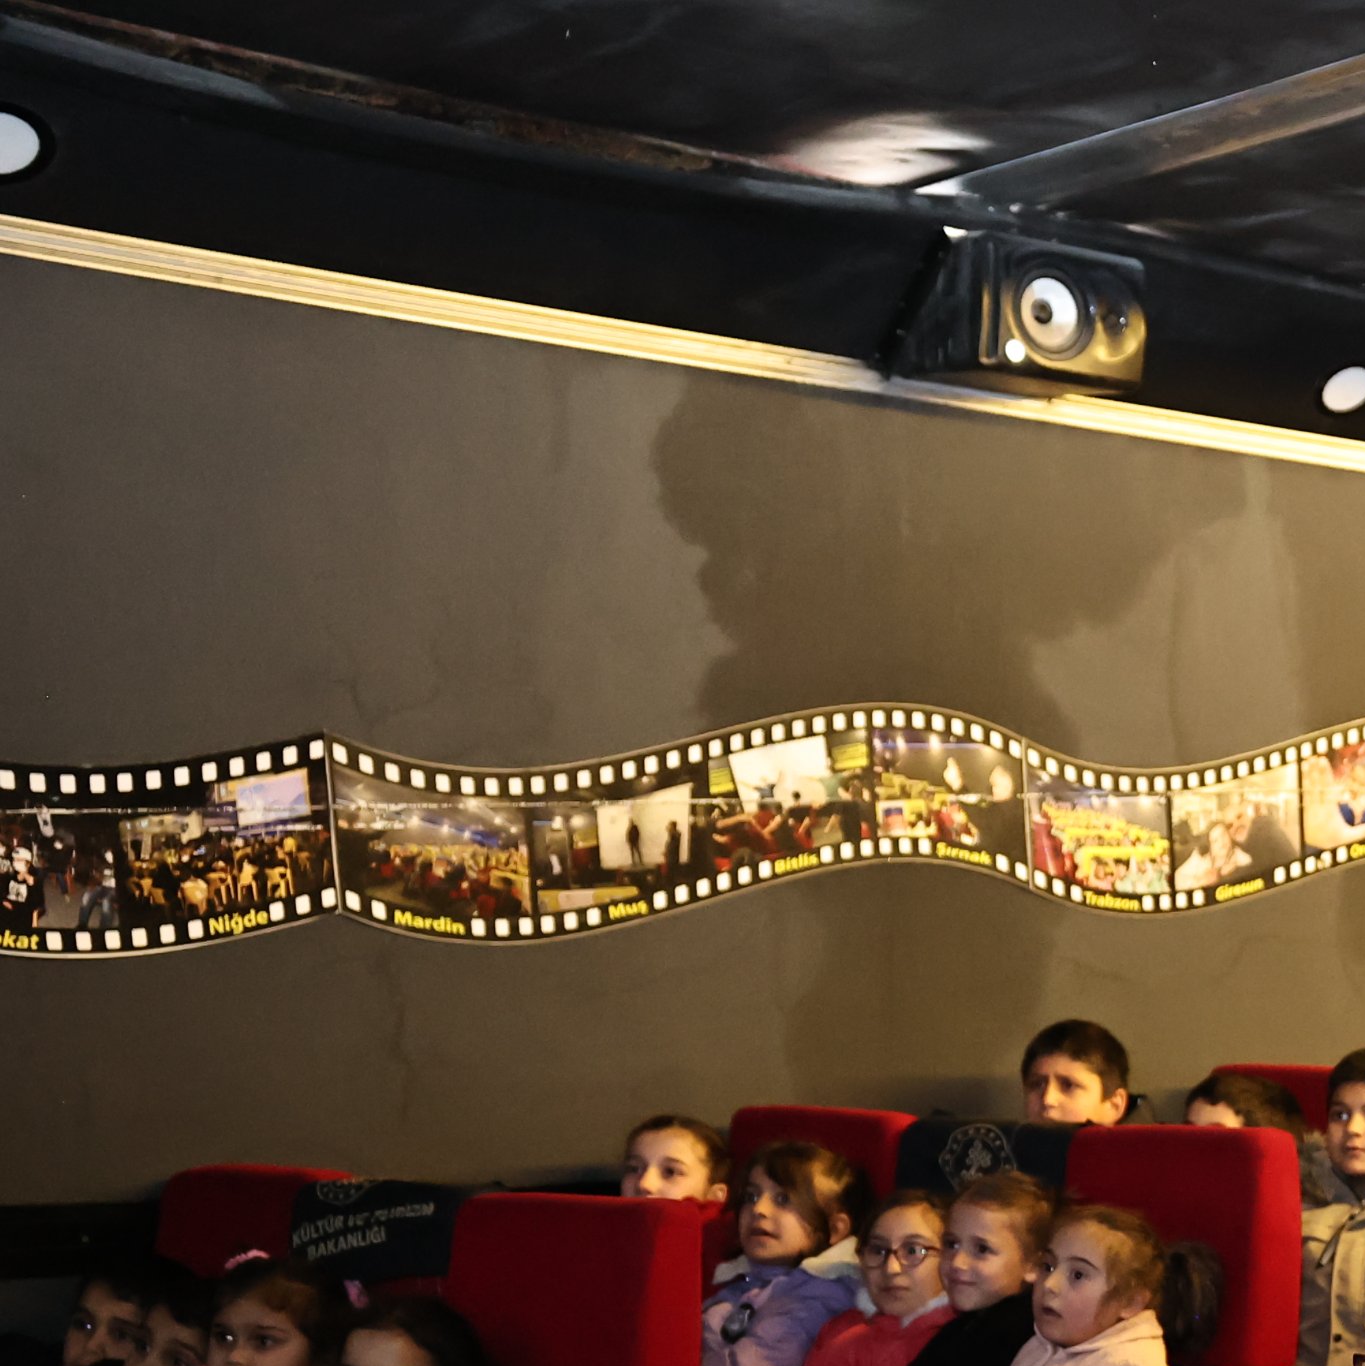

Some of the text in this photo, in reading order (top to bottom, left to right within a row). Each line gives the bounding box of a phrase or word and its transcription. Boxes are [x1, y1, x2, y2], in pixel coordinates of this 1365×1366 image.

[1084, 890, 1140, 912] Trabzon
[208, 909, 268, 936] Niğde
[394, 909, 466, 936] Mardin
[0, 929, 39, 950] kat
[292, 1214, 344, 1249] KÜLTÜR
